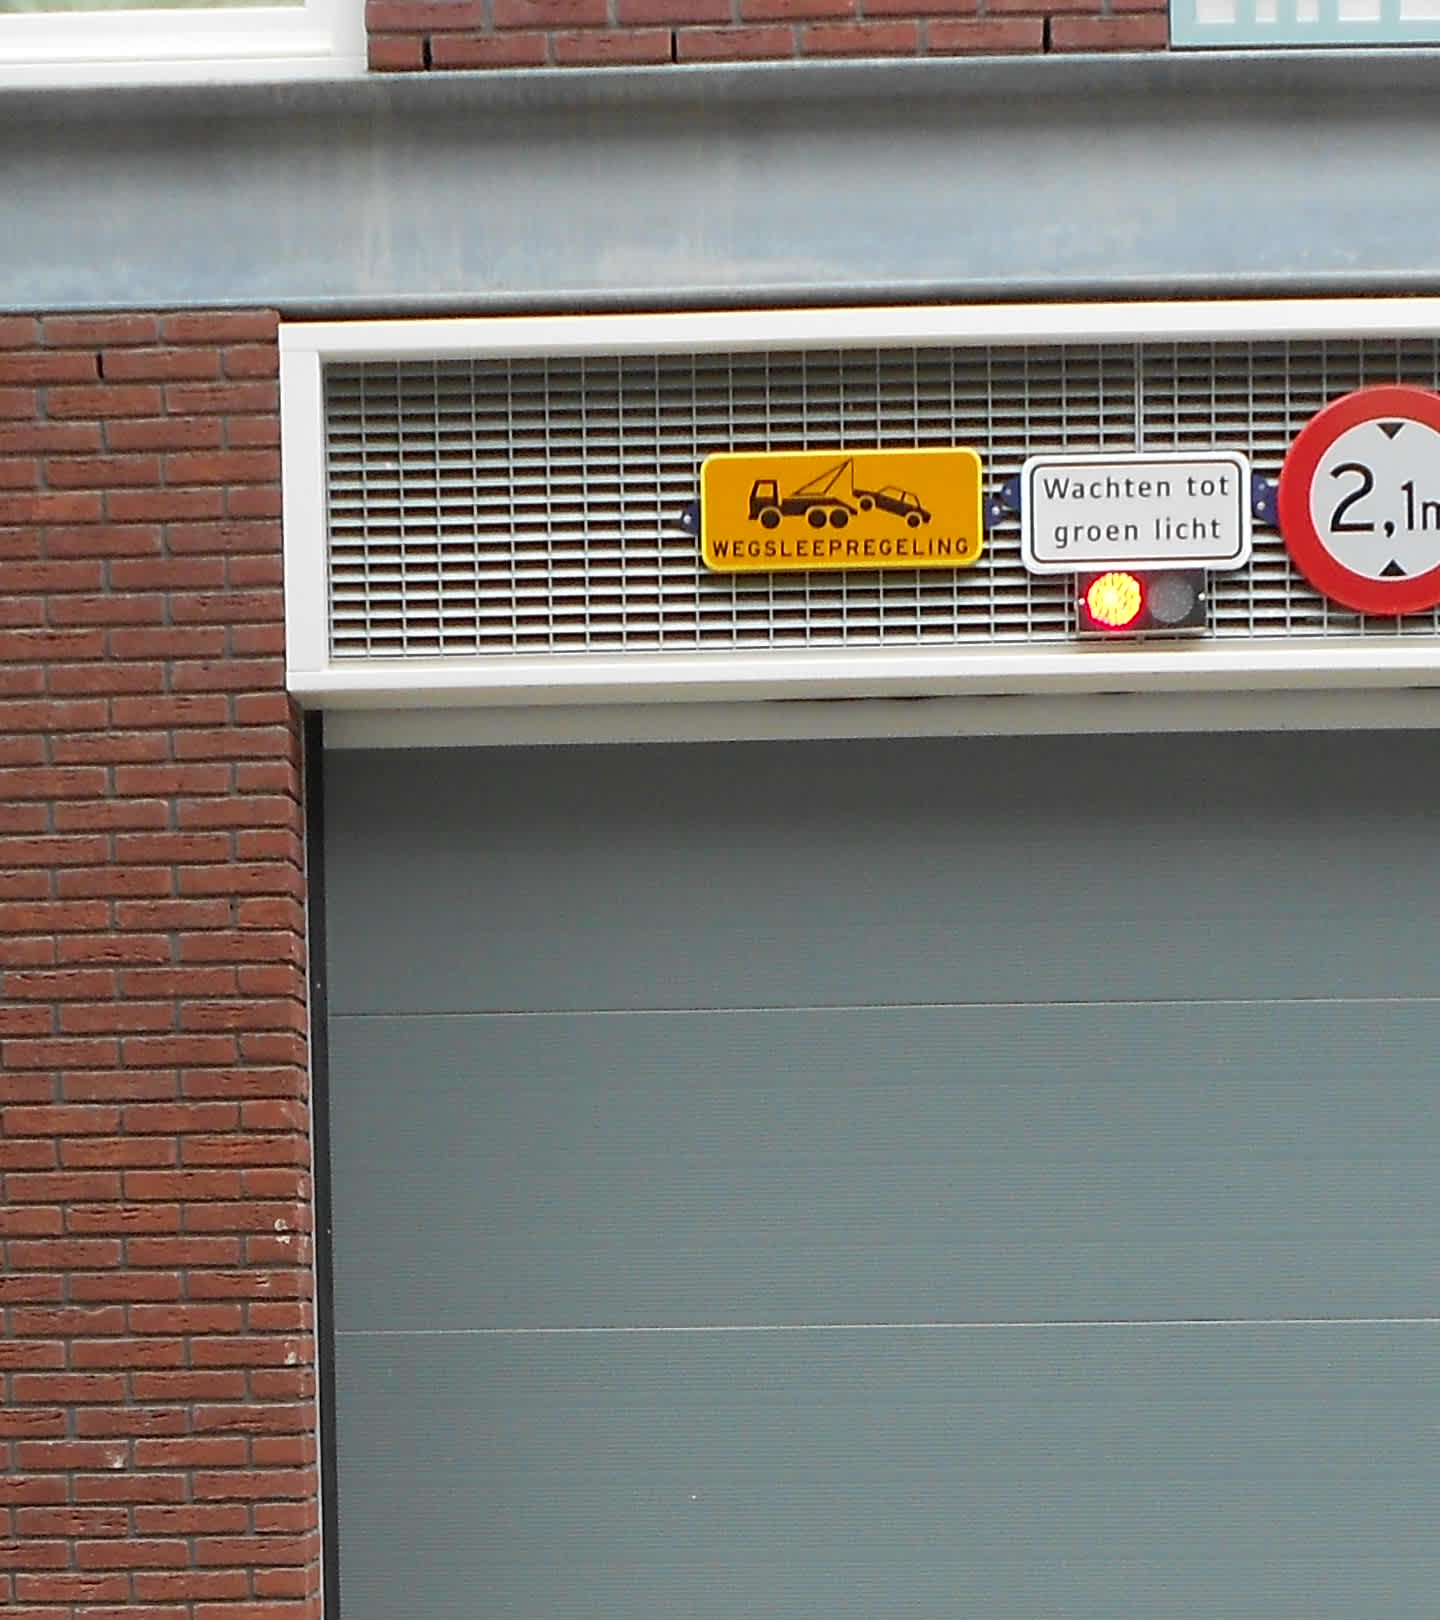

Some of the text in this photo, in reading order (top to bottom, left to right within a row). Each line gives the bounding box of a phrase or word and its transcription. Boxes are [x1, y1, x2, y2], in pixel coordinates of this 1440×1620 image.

[1043, 475, 1229, 500] Wachten tot
[1054, 516, 1221, 549] groen licht
[713, 537, 969, 558] WEGSLEEPREGELING
